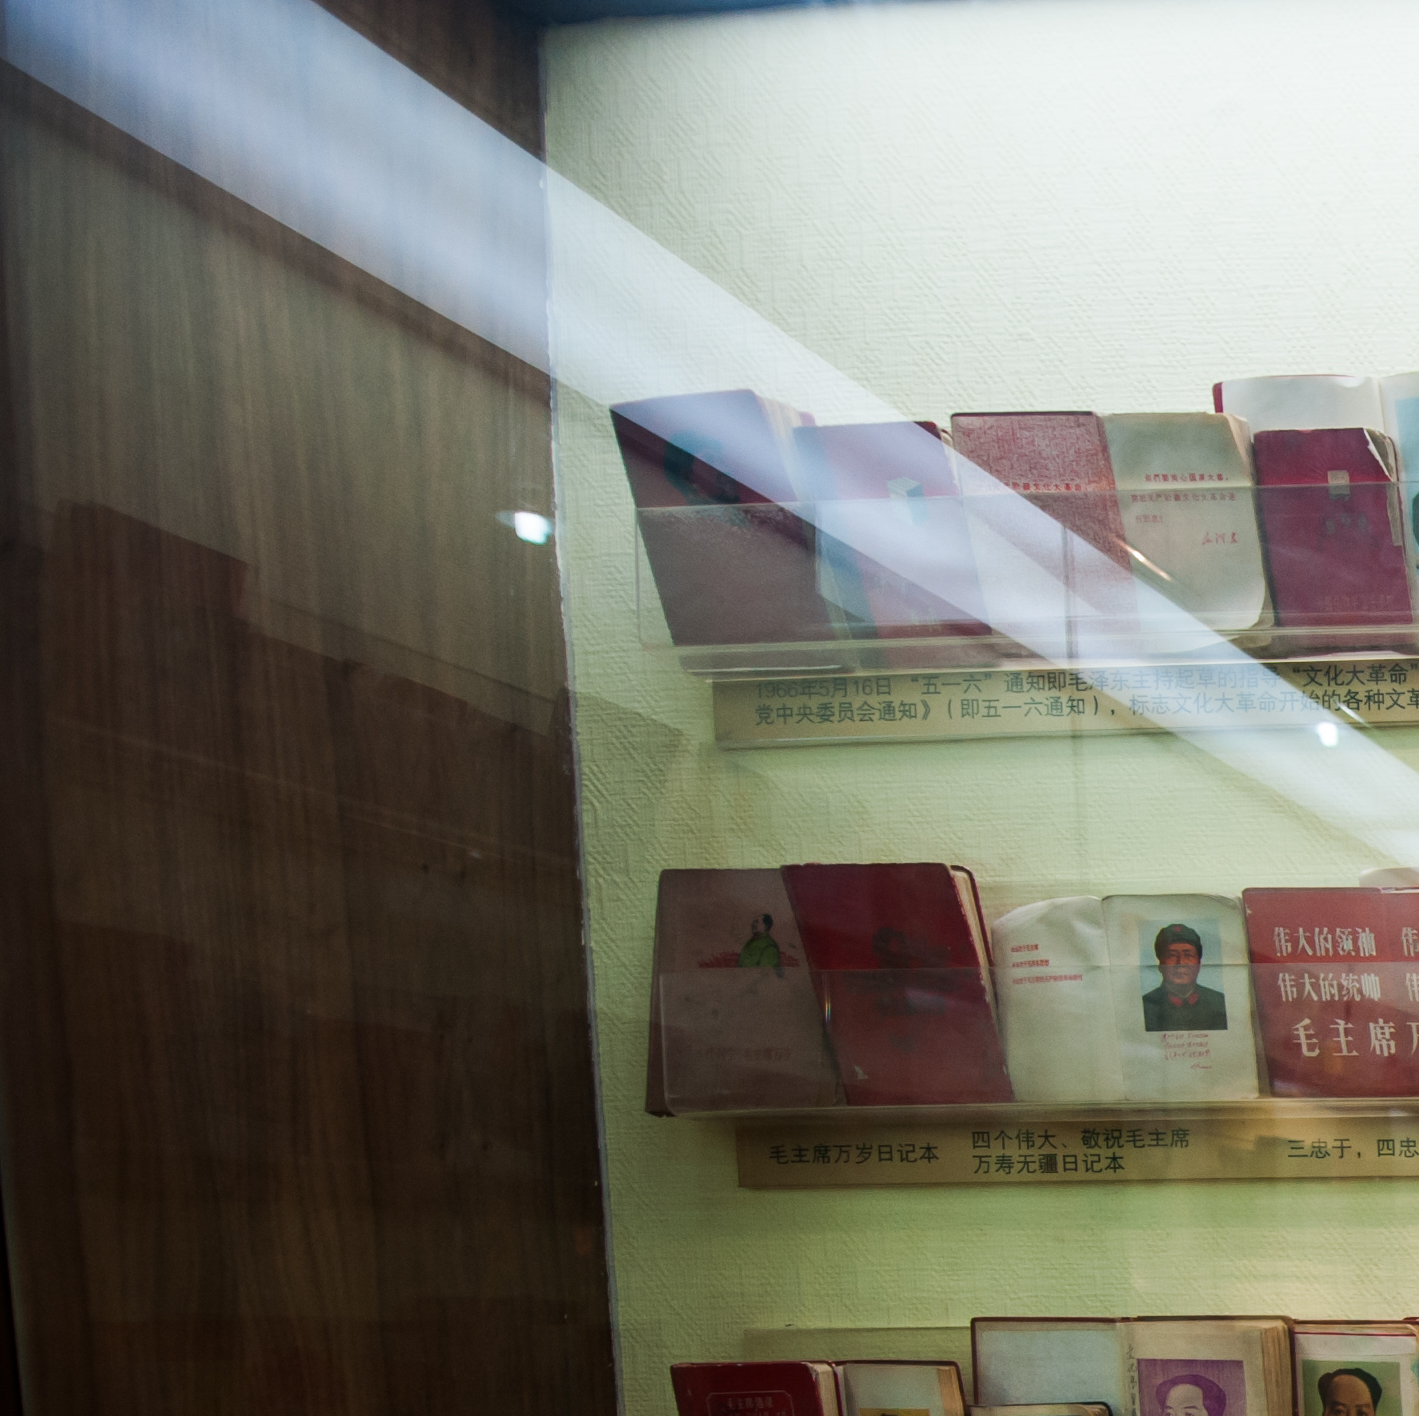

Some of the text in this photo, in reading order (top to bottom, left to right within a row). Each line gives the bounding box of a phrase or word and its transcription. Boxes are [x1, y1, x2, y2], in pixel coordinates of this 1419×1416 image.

[1273, 926, 1378, 958] 伟大的领袖
[1277, 972, 1382, 1003] 伟大的统帅
[971, 1127, 1190, 1150] 四个伟大、敬祝毛主席
[768, 1143, 940, 1165] 毛主席万岁日记本
[971, 1152, 1126, 1175] 万寿无疆日记本
